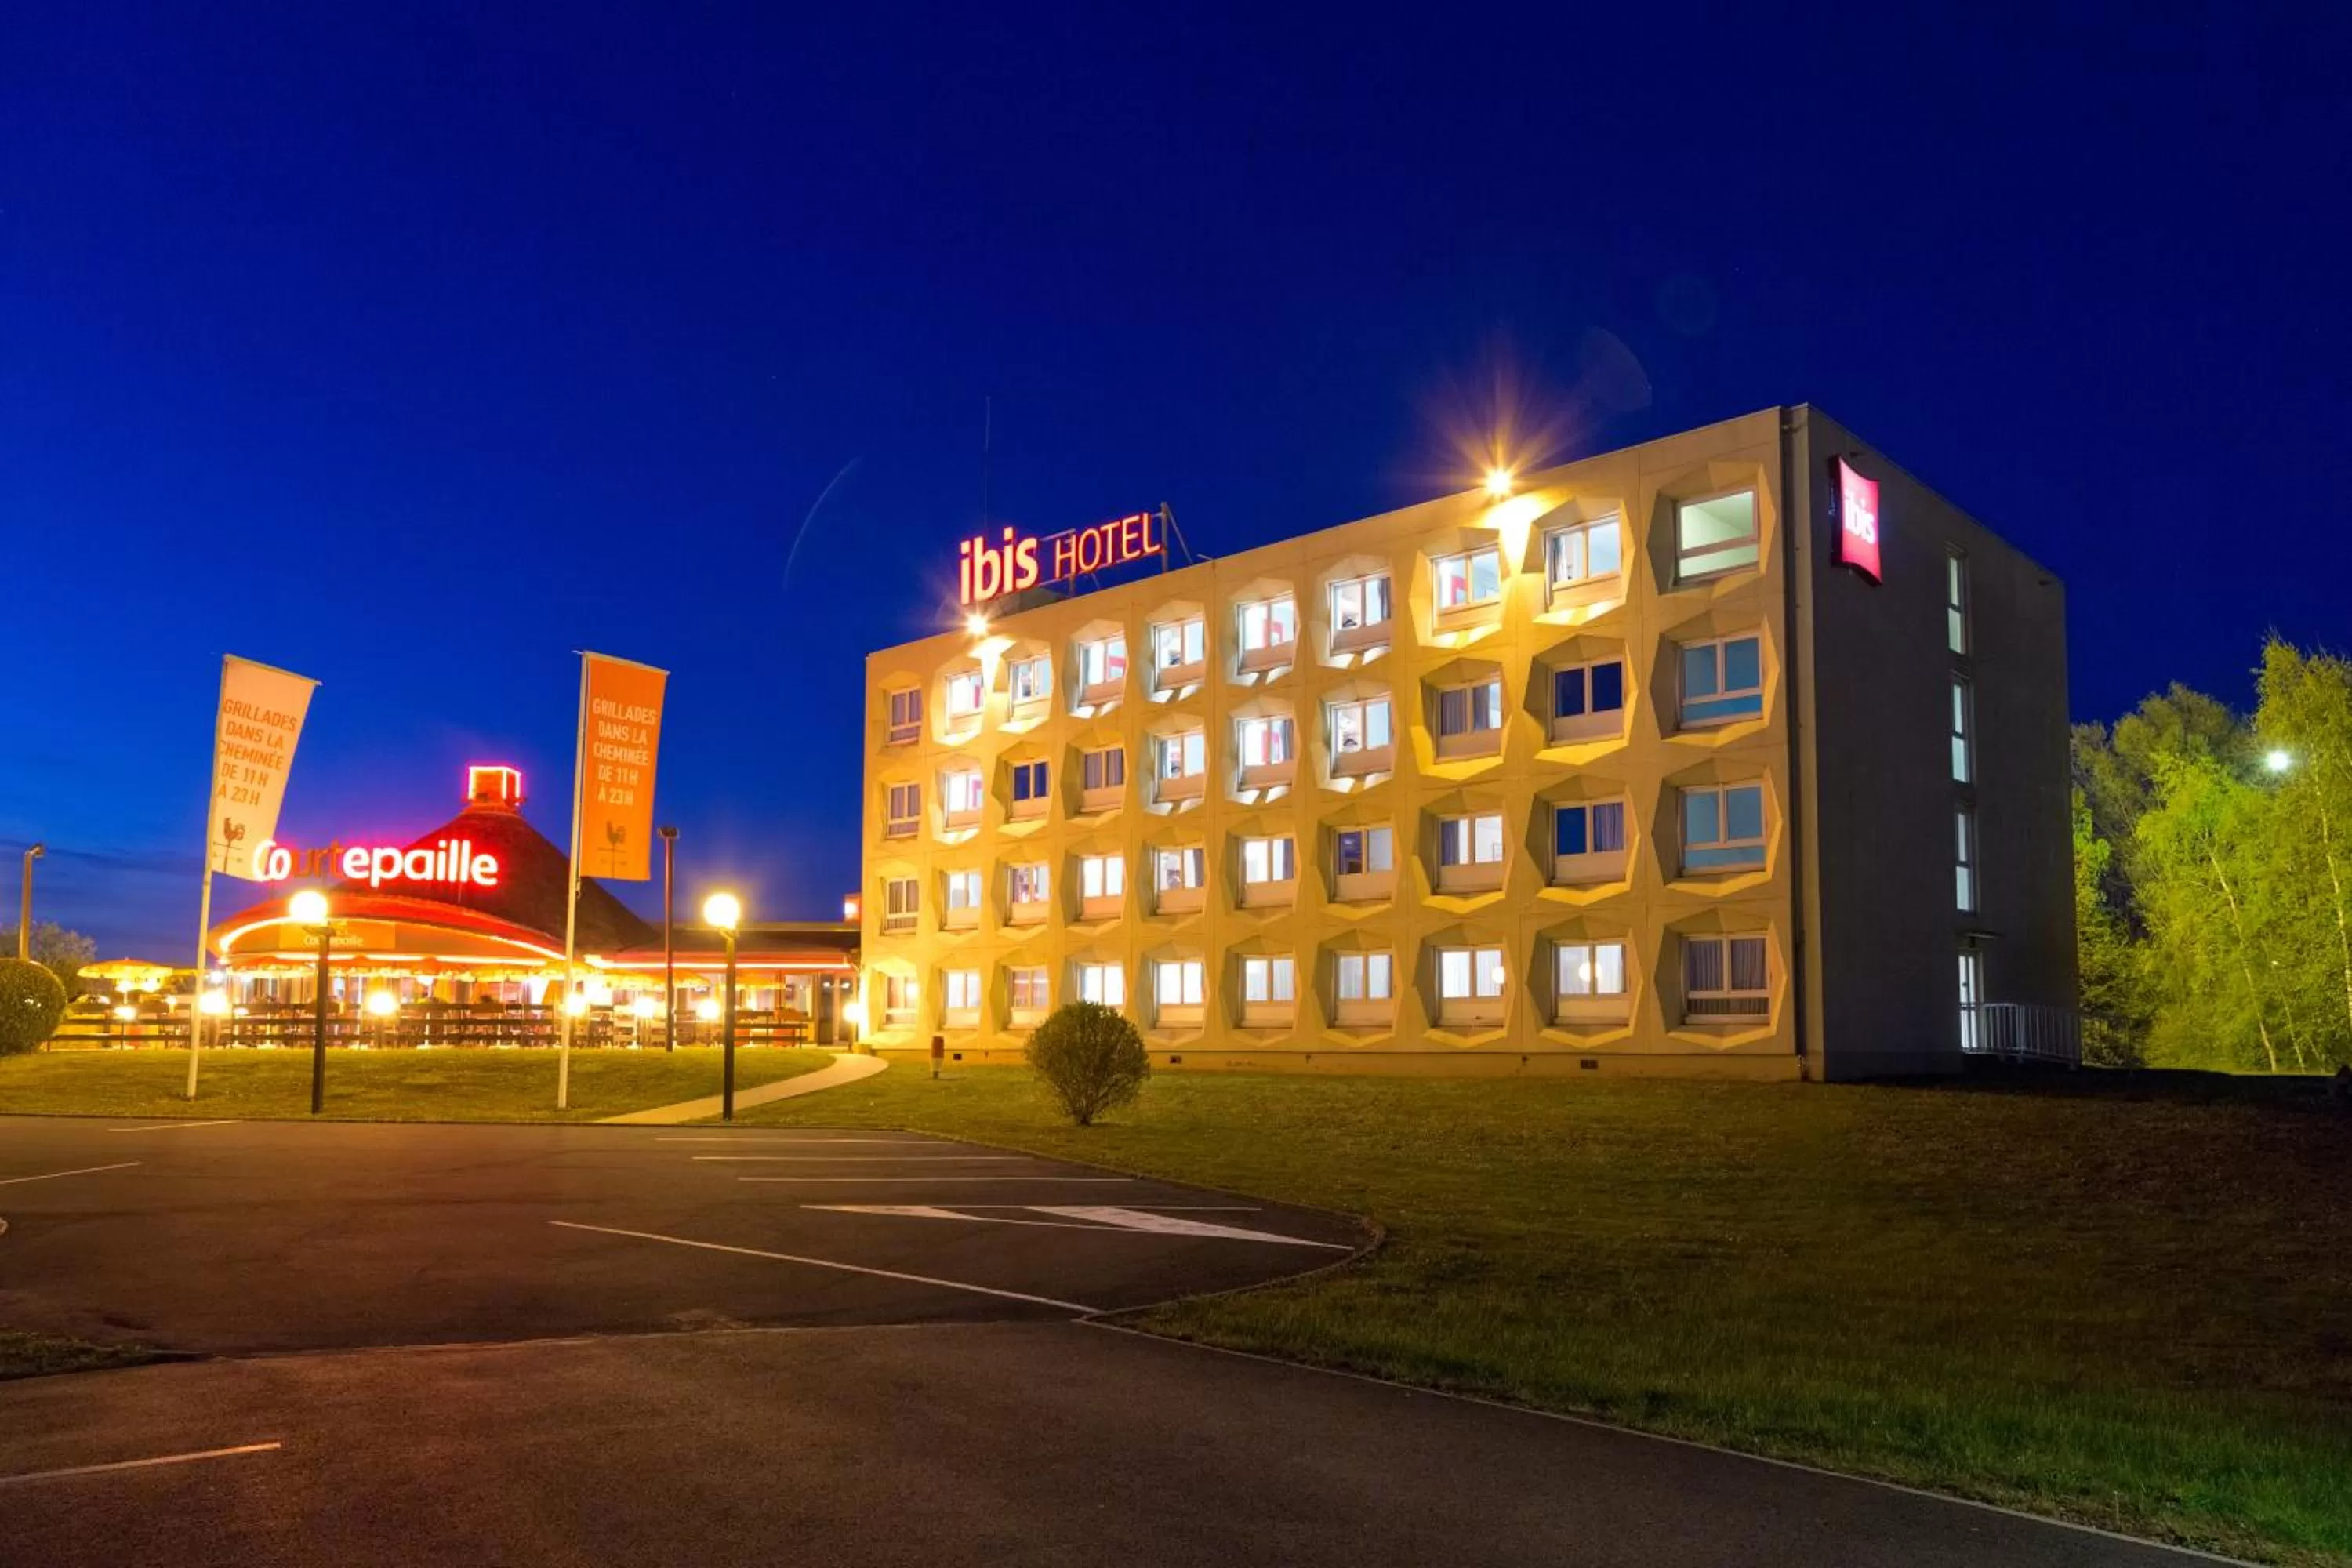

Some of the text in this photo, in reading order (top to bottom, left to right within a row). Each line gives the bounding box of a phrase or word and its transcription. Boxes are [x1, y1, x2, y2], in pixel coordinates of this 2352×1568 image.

[1844, 488, 1875, 544] ibis
[960, 512, 1160, 605] ibis HOTEL
[223, 699, 297, 732] GRILLADES
[593, 698, 657, 726] GRILLADES
[225, 720, 284, 750] DANS LA
[598, 720, 648, 746] DANS LA
[221, 761, 238, 780] DE
[597, 764, 612, 782] DE
[252, 839, 499, 888] Courtepaille
